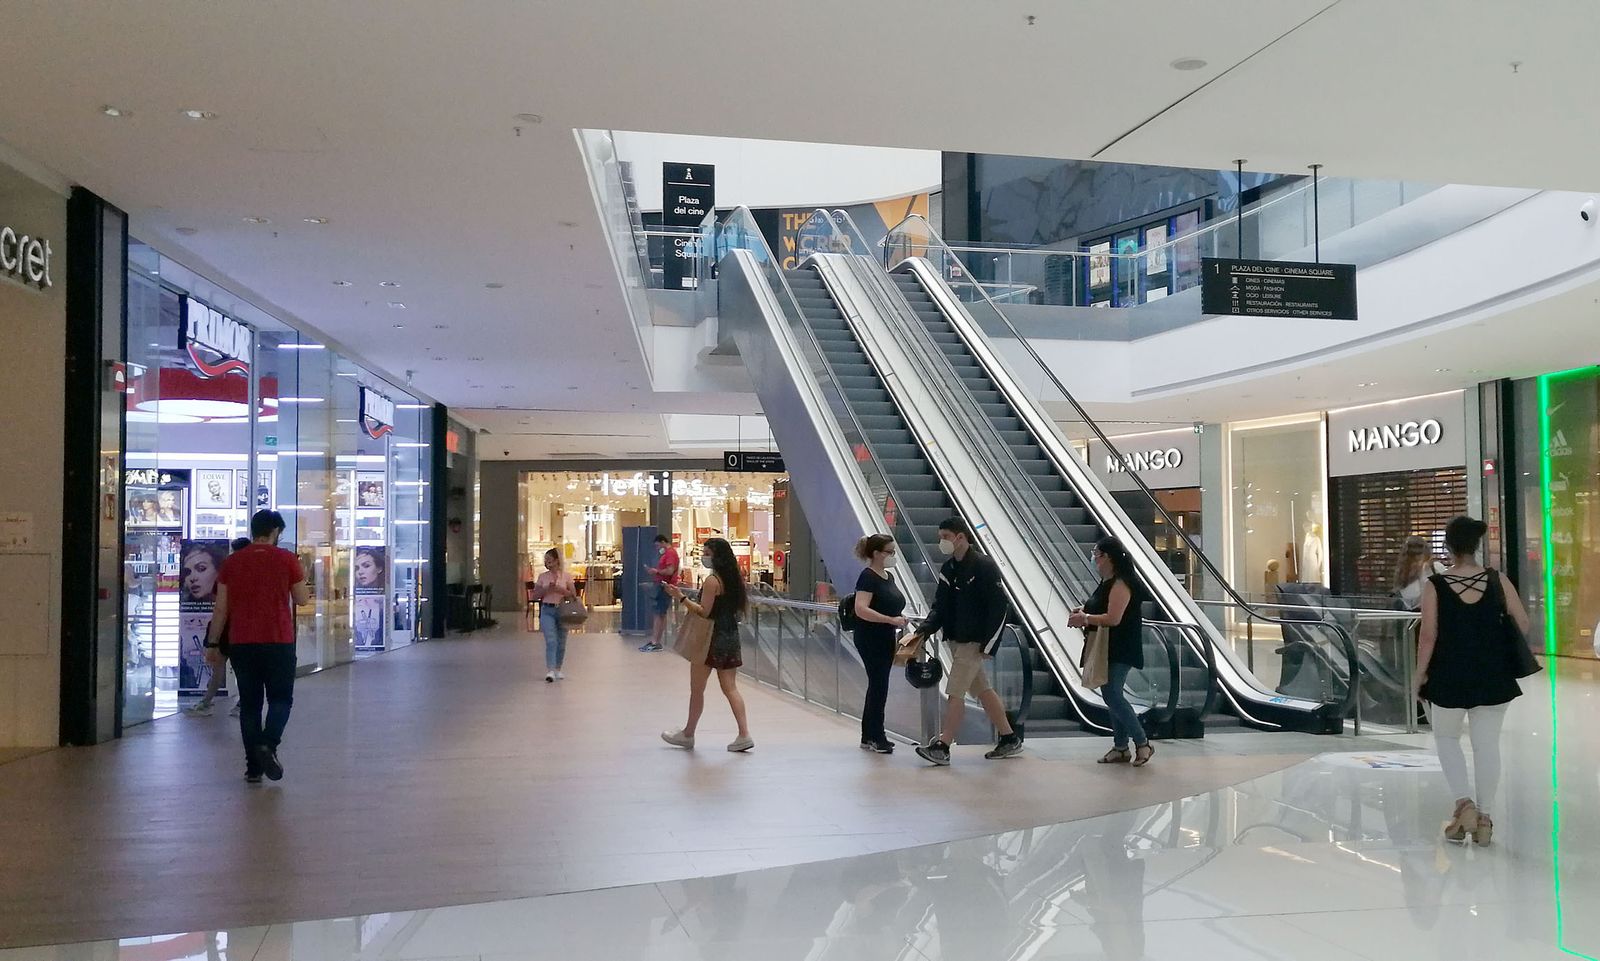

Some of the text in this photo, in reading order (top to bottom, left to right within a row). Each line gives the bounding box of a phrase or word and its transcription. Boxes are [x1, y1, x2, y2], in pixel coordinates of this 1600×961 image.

[674, 207, 705, 216] del cine
[678, 196, 700, 205] Plaza
[0, 226, 53, 288] cret
[1214, 263, 1220, 274] 1
[1231, 264, 1252, 273] PLAZA
[1264, 266, 1280, 274] CINE
[1284, 267, 1308, 275] CINEMA
[1308, 268, 1334, 277] SQUARE
[187, 297, 250, 364] PRIMOR
[1348, 418, 1443, 454] MANGO
[1105, 447, 1184, 473] MANGO
[602, 471, 702, 495] lefties
